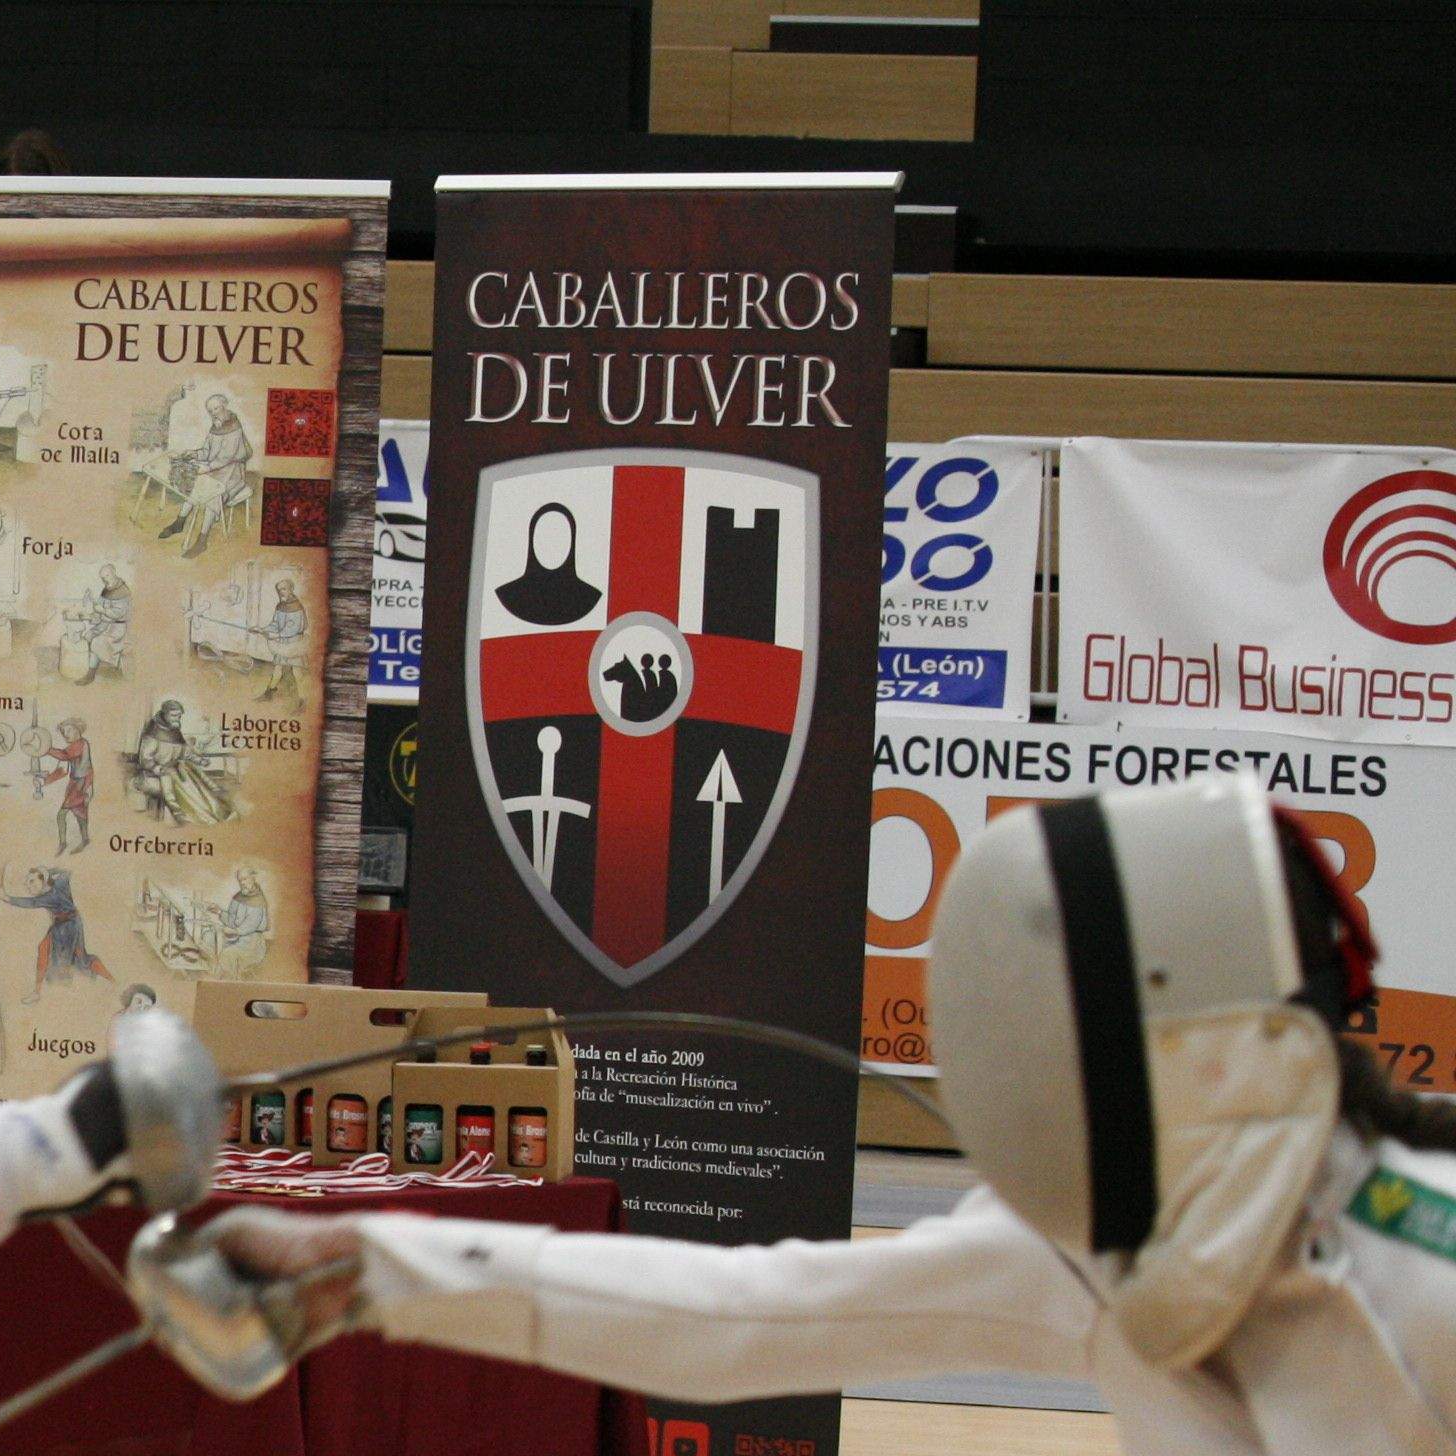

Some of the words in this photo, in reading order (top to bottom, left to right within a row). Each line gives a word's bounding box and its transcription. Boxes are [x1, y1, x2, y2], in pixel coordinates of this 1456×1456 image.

[73, 277, 319, 314] CABALLEROS
[467, 270, 860, 331] CABALLEROS
[74, 322, 140, 363] DE
[156, 323, 313, 366] ULVER
[464, 351, 571, 424] DE
[593, 352, 853, 428] ULVER
[58, 423, 103, 442] Cota
[41, 447, 62, 463] de
[71, 445, 120, 465] Malla
[913, 598, 948, 612] PRE
[932, 616, 969, 629] ABS
[892, 653, 984, 680] (León)
[1084, 633, 1220, 709] Global
[1238, 644, 1455, 724] Business
[221, 712, 302, 734] Labores
[220, 729, 302, 752] textiles
[27, 1030, 96, 1056] Juegos
[605, 1049, 620, 1061] en
[625, 1048, 637, 1062] el
[641, 1050, 667, 1064] año
[672, 1051, 705, 1067] 2009
[606, 1067, 677, 1086] Recreación
[600, 1088, 615, 1103] de
[719, 1101, 733, 1112] en
[575, 1127, 590, 1143] de
[593, 1129, 639, 1147] Castilla
[642, 1137, 650, 1151] y
[655, 1134, 688, 1150] León
[692, 1140, 727, 1154] como
[731, 1143, 753, 1156] una
[756, 1144, 825, 1161] asociación
[574, 1150, 616, 1166] cultura
[632, 1156, 702, 1174] tradiciones
[645, 1200, 713, 1217] reconocida
